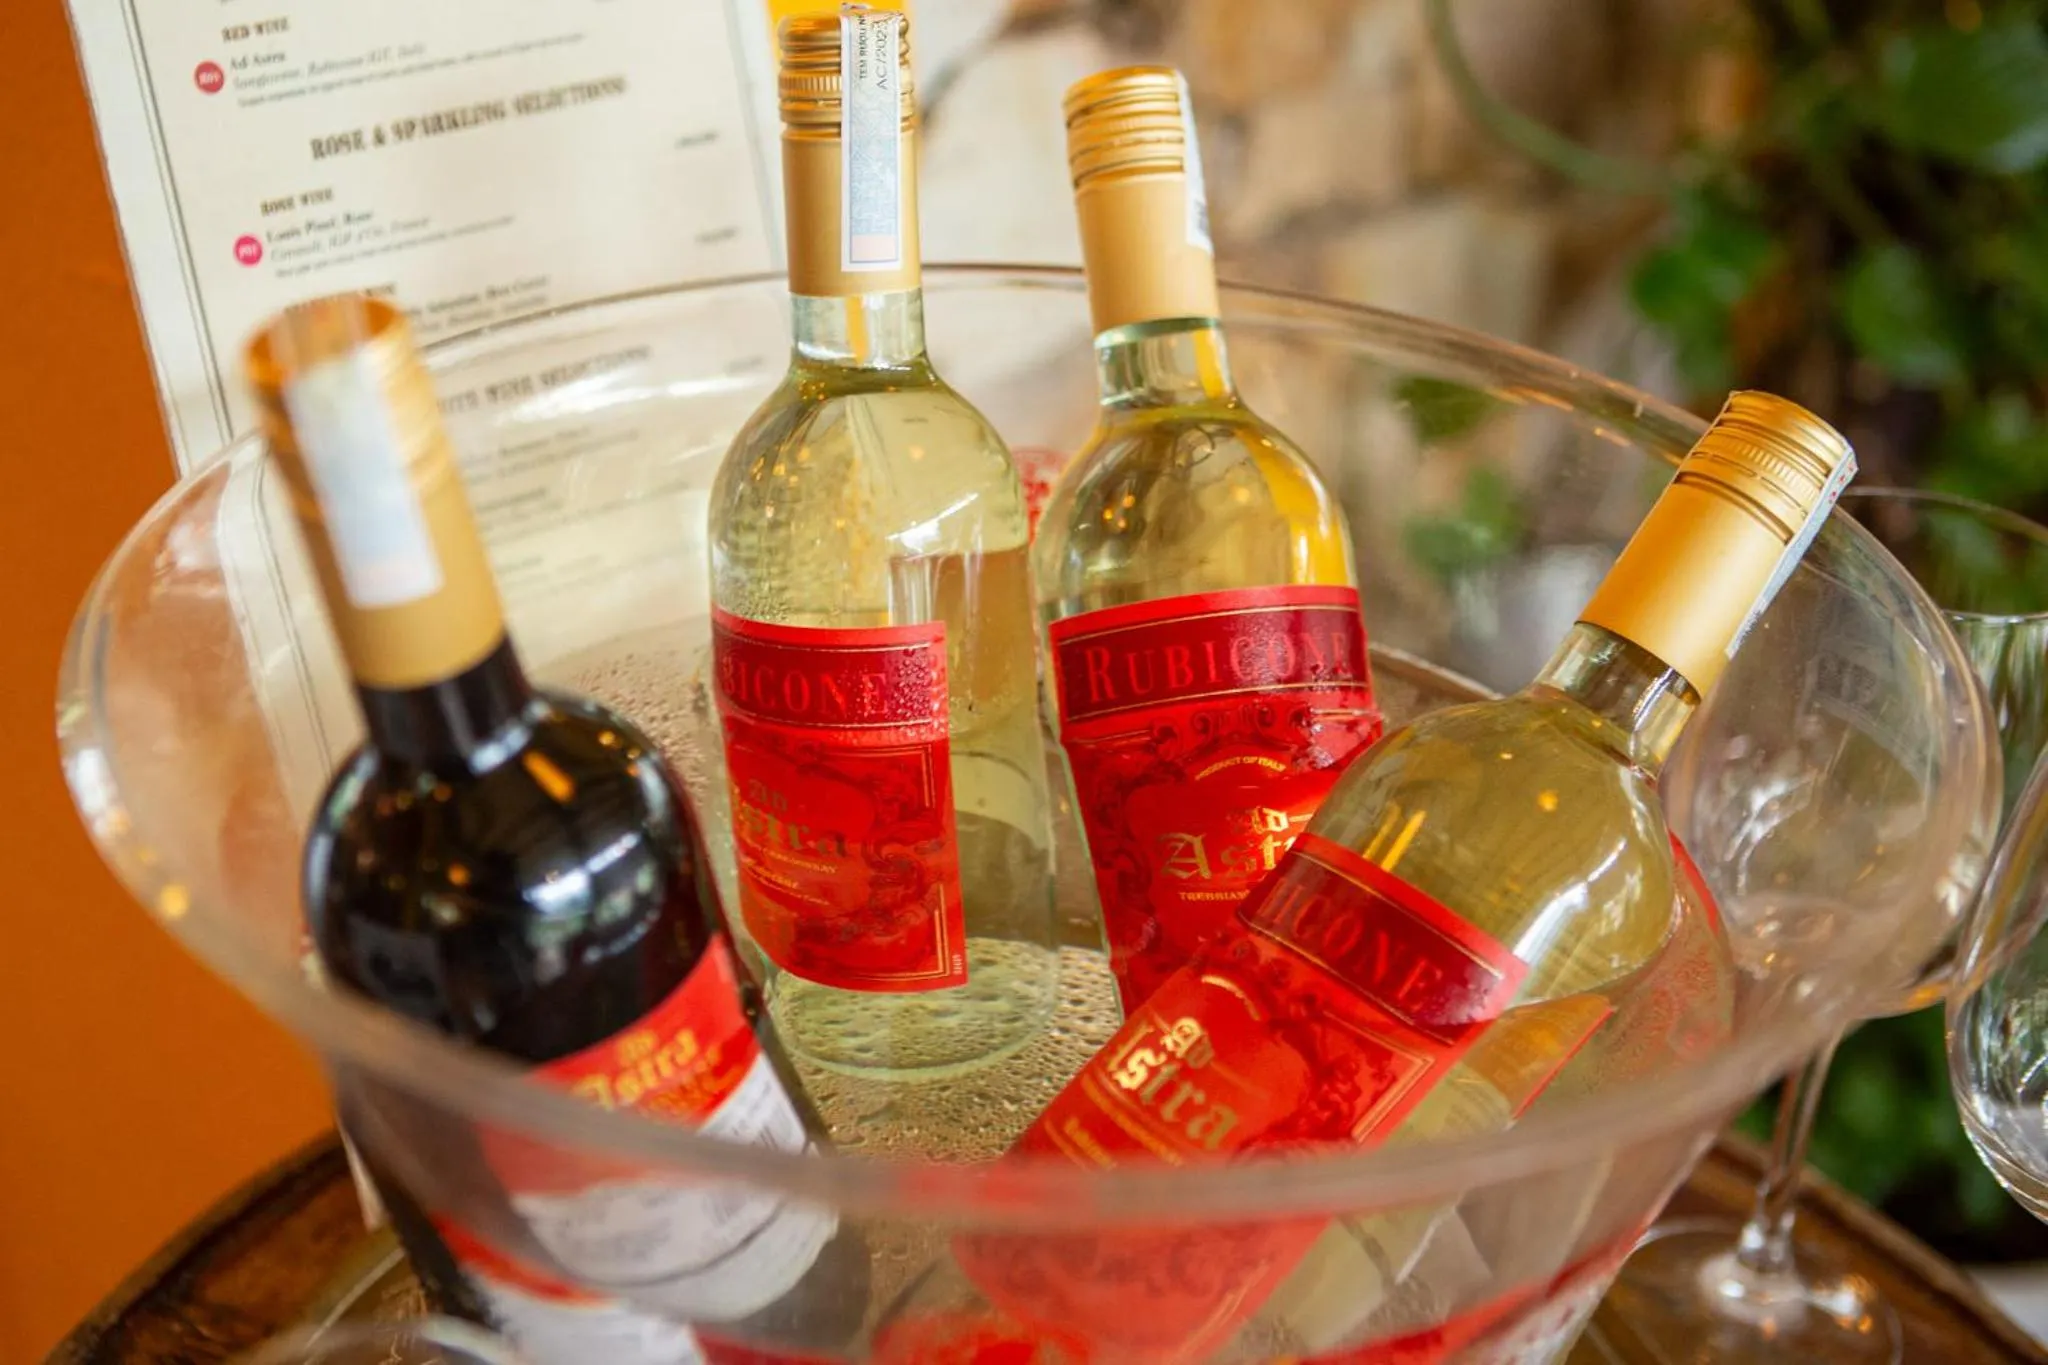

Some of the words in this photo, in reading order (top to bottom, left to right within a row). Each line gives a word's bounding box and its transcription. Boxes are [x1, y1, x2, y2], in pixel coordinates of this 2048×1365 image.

[221, 26, 250, 42] RED
[253, 17, 289, 35] WINE
[373, 123, 386, 147] &
[391, 98, 507, 142] SPARKLING
[1085, 631, 1354, 703] RUBICONE
